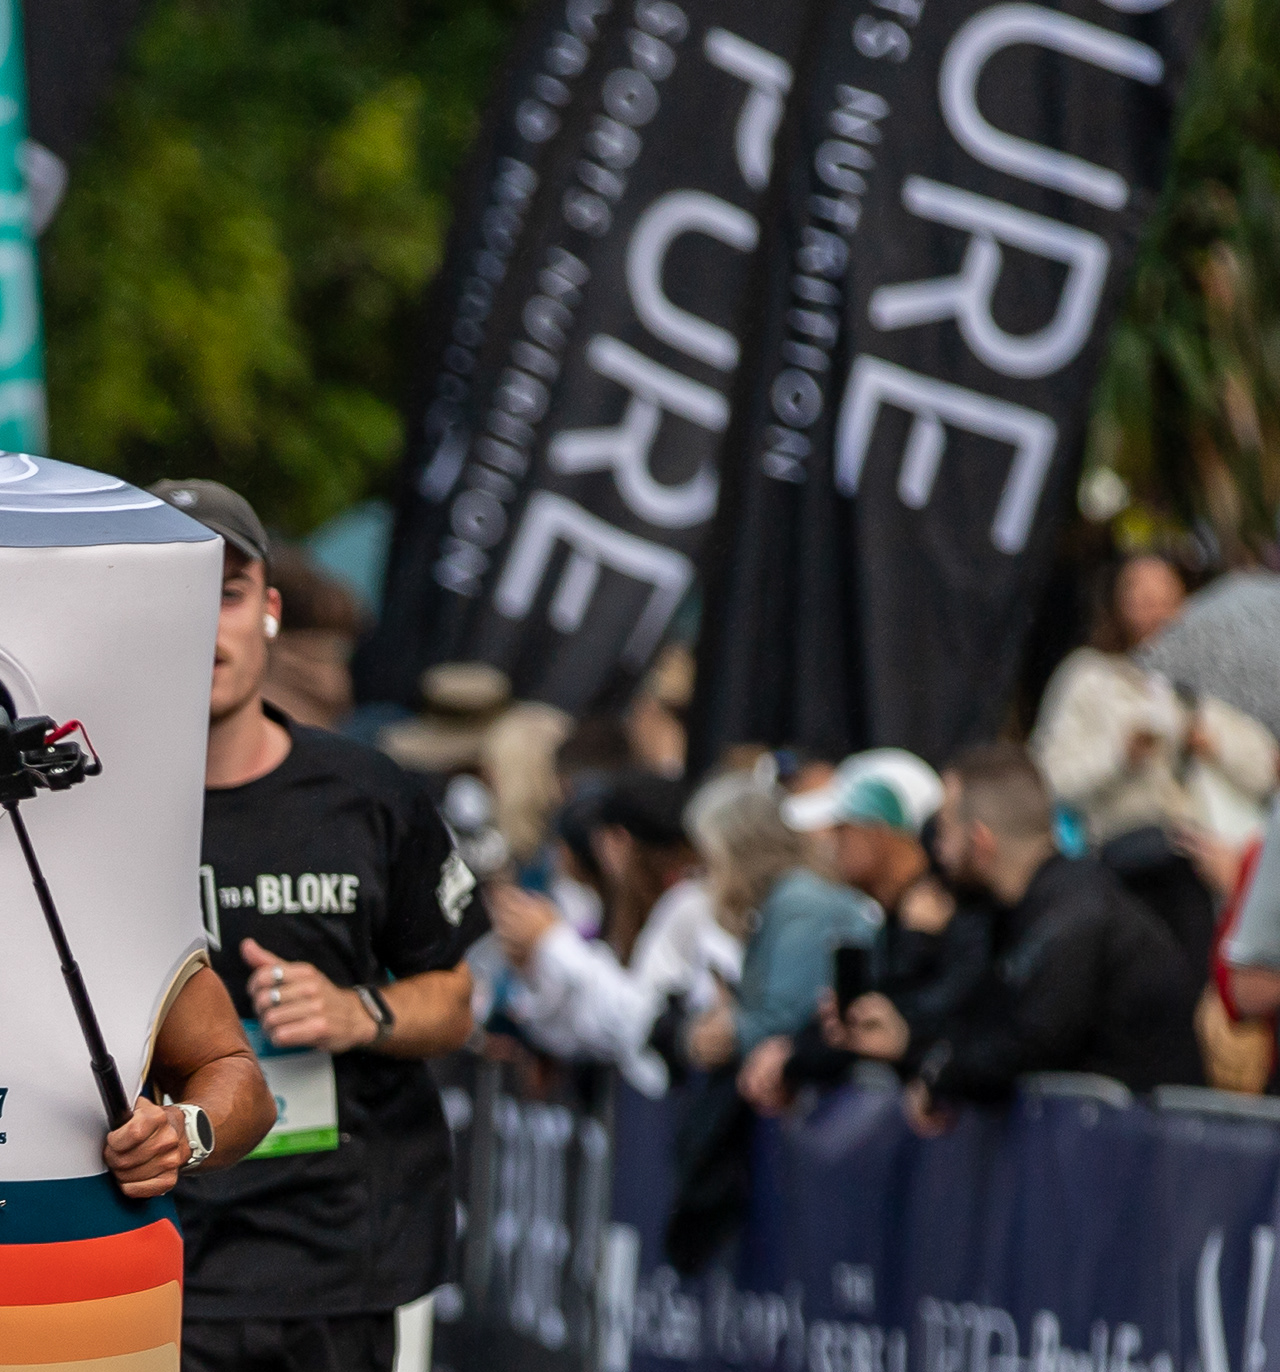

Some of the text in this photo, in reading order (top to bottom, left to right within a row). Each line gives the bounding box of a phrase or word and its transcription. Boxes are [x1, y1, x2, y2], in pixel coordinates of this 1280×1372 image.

[432, 245, 590, 597] NUTRITION
[760, 83, 870, 484] NUTRITION
[835, 0, 1180, 555] URE
[257, 873, 360, 915] BLOKE
